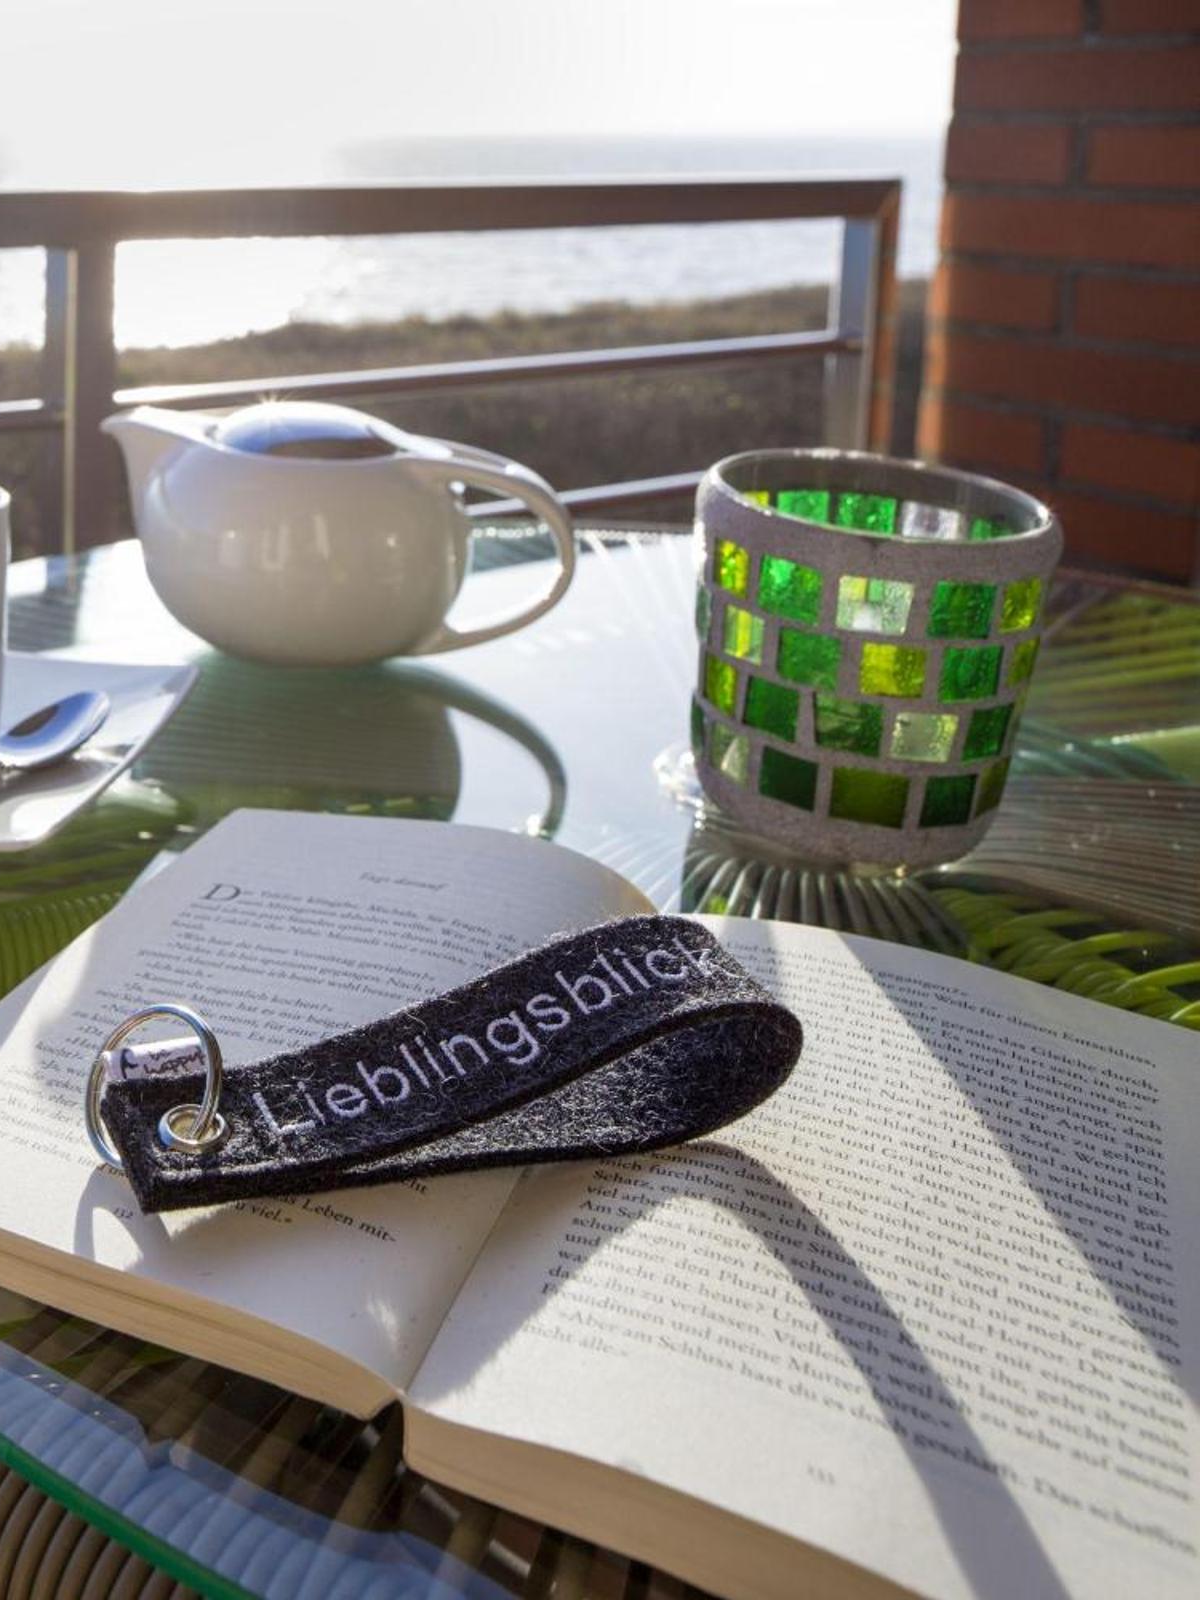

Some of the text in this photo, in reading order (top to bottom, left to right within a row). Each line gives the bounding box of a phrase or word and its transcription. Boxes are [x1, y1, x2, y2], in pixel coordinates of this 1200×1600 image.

[252, 937, 712, 1136] Lieblingsblick
[1115, 1111, 1161, 1132] noch
[1137, 1171, 1166, 1190] ich
[1138, 1186, 1167, 1204] ich
[301, 1198, 354, 1227] Leben
